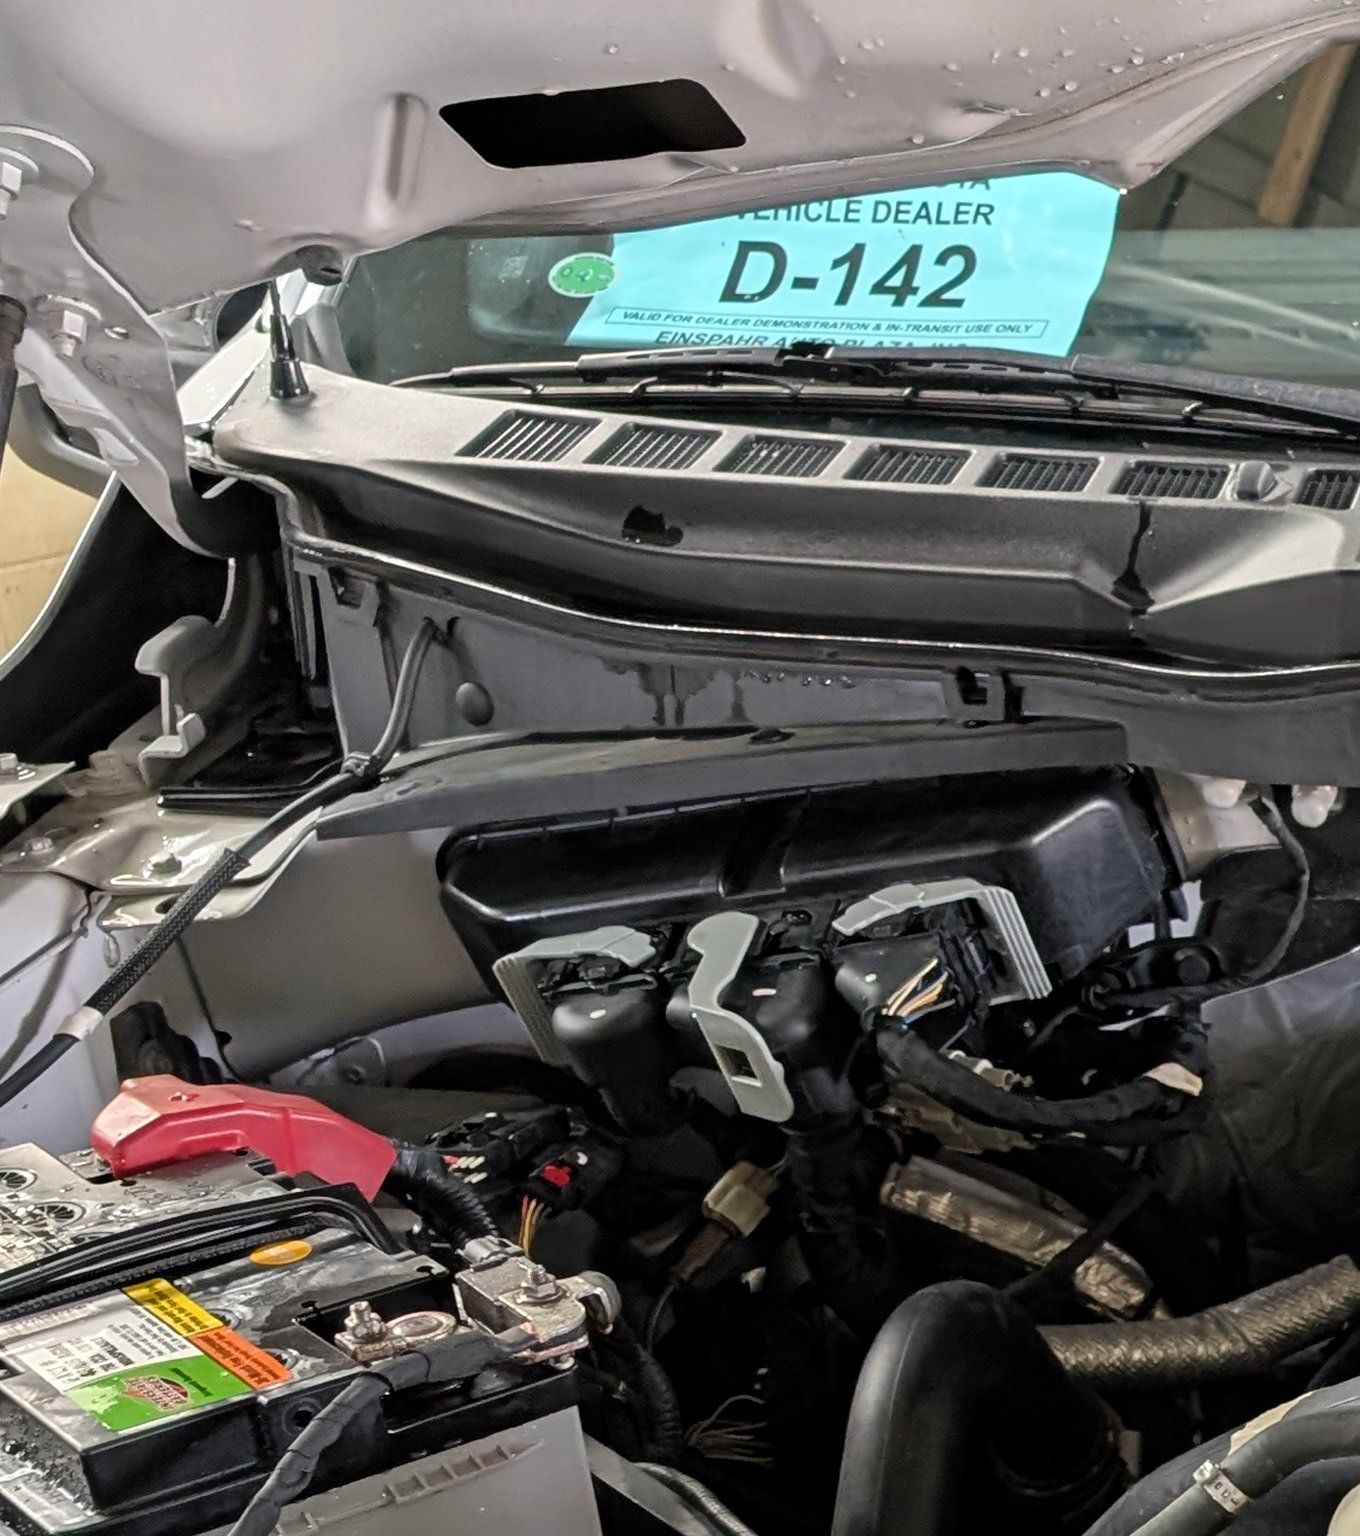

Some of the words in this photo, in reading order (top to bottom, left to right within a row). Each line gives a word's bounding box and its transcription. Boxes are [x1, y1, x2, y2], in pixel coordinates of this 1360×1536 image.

[871, 200, 995, 225] DEALER
[718, 240, 977, 308] D-142
[622, 310, 661, 321] VALID
[663, 313, 694, 323] FOR
[694, 316, 750, 326] DEALER
[752, 319, 870, 331] DEMONSTRATION
[871, 322, 883, 332] &
[884, 322, 962, 333] IN-TRANSIT
[964, 323, 991, 333] USE
[994, 323, 1034, 333] ONLY
[654, 331, 768, 346] EINSPAHR
